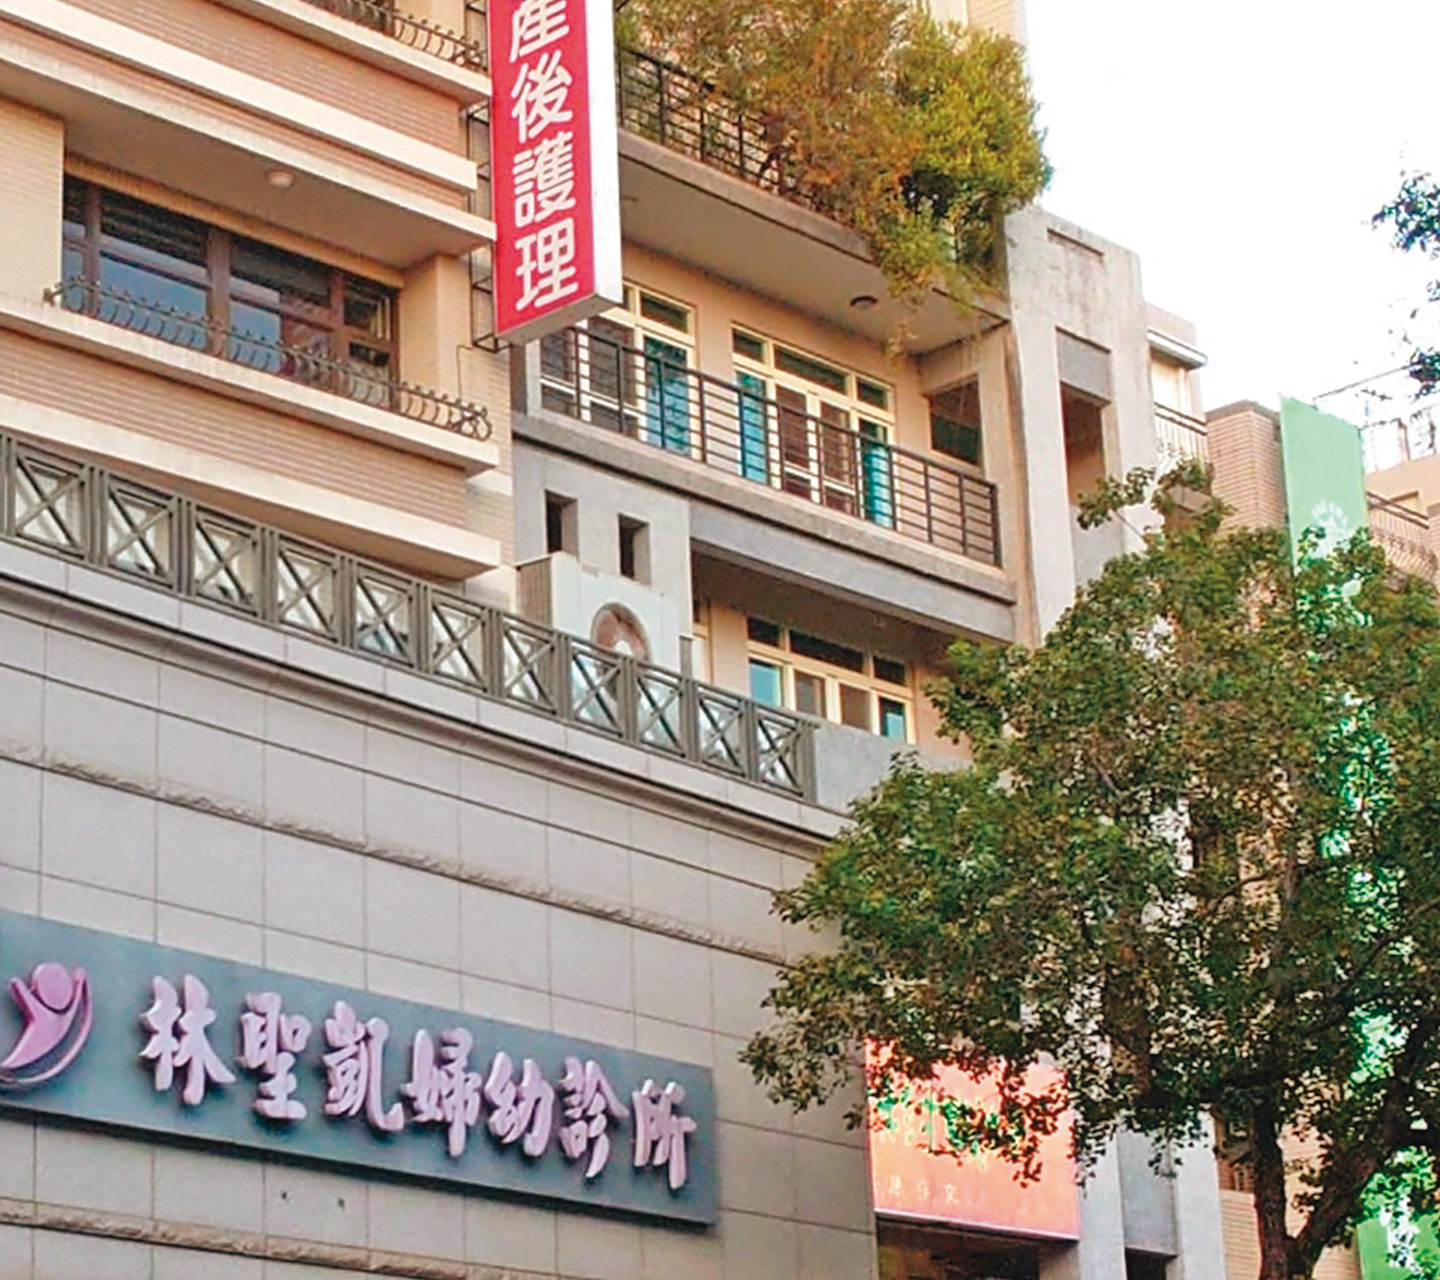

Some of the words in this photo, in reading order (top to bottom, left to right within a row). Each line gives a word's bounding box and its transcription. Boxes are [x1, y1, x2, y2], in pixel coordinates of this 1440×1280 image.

[139, 972, 697, 1191] 林聖凱婦幼診所
